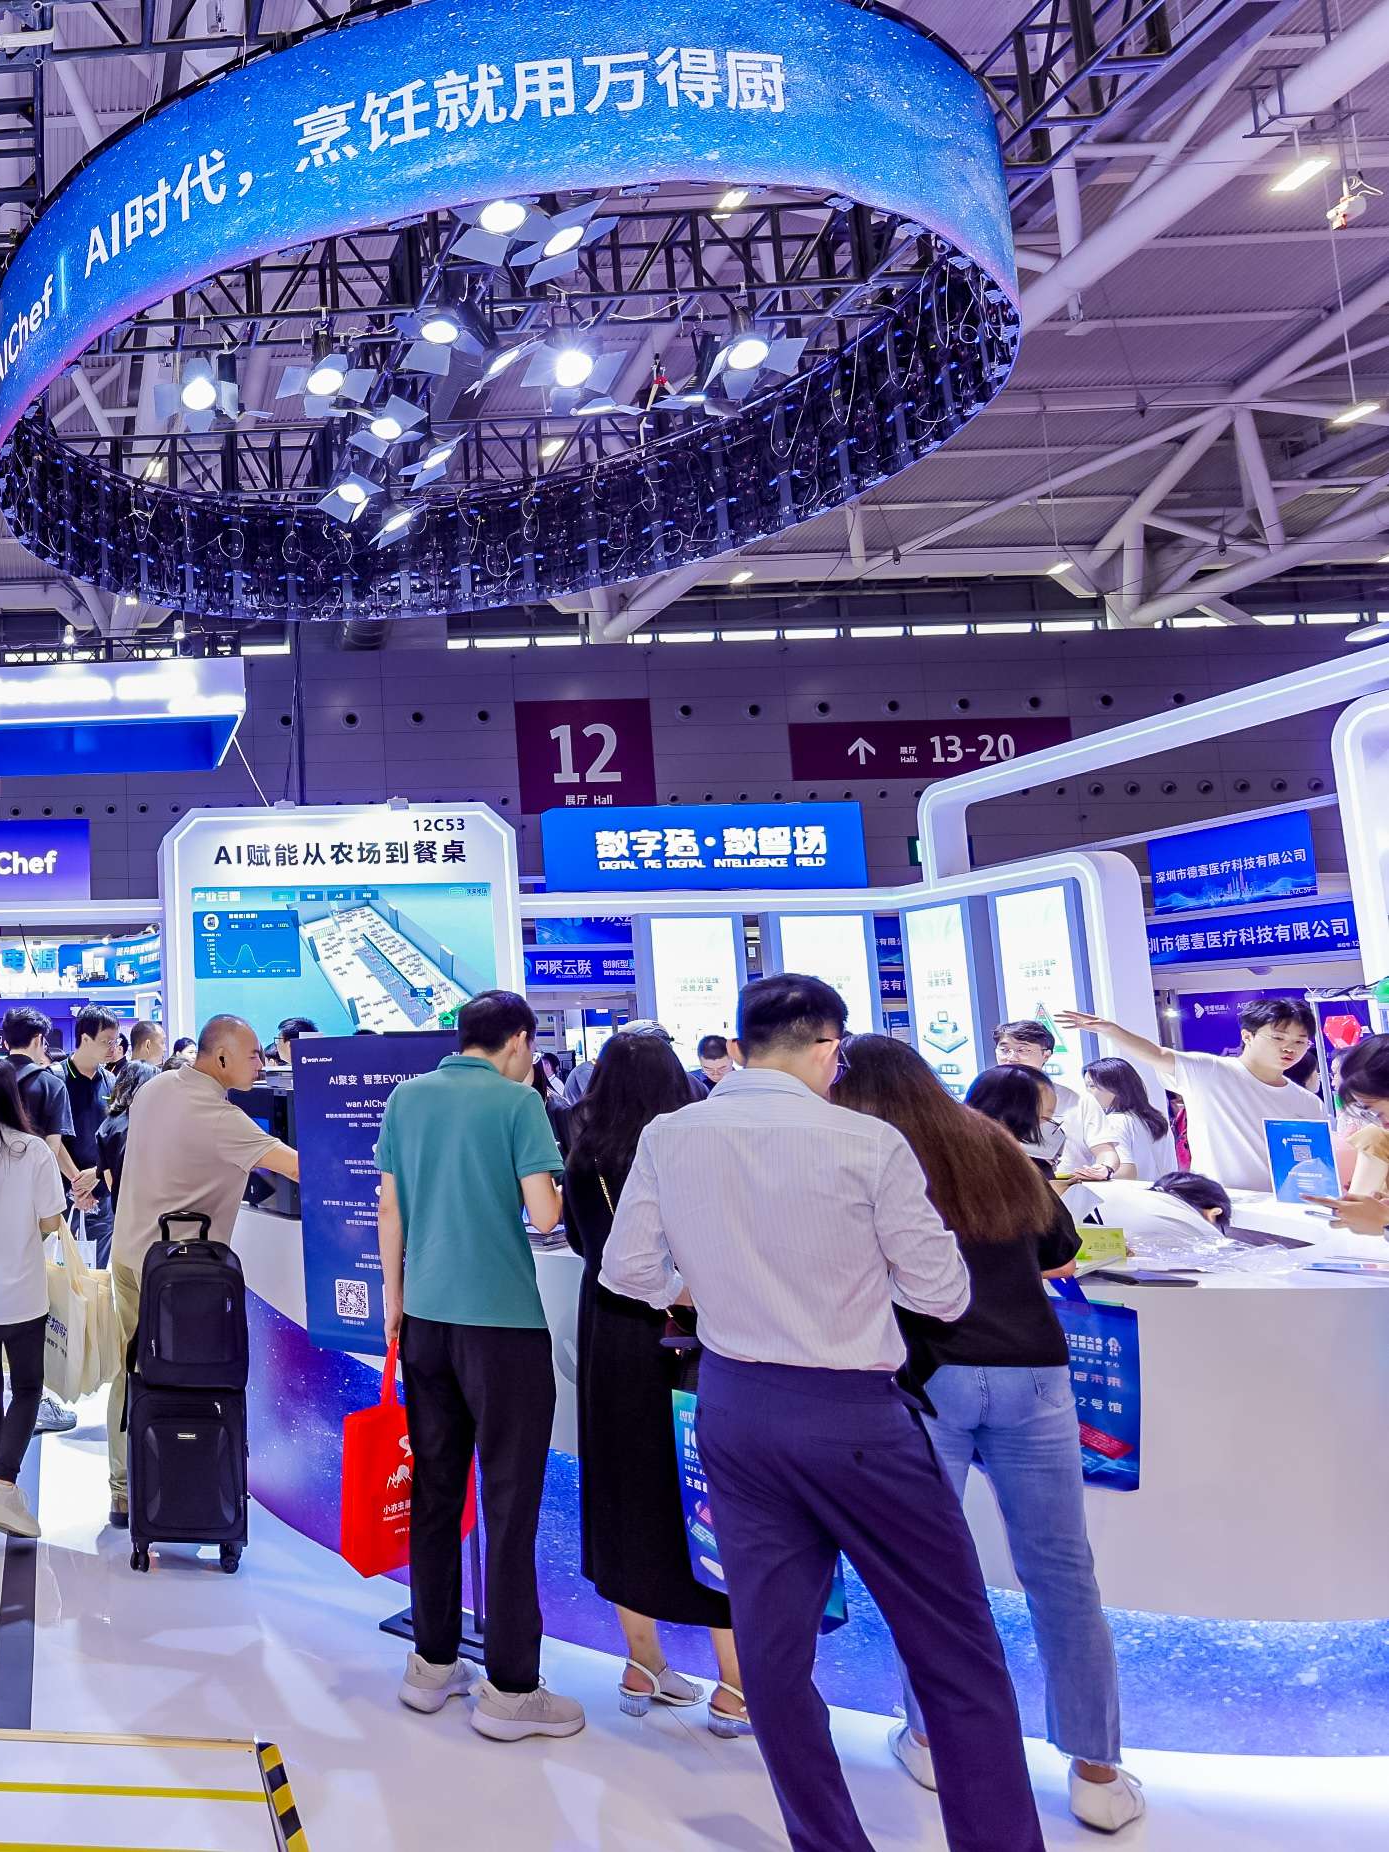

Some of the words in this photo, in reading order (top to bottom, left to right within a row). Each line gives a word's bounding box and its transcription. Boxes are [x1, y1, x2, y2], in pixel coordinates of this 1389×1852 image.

[83, 150, 256, 276] AI时代，
[294, 47, 785, 172] 烹饪就用万得厨
[549, 723, 622, 784] 12
[899, 746, 917, 755] 展厅
[929, 734, 1016, 763] 13-20
[900, 755, 918, 763] Halls
[565, 794, 588, 805] 展厅
[593, 794, 613, 805] Hall
[413, 818, 465, 832] 12C53
[213, 840, 466, 867] AI赋能从农场到餐桌
[598, 860, 639, 870] DIGITAL
[644, 860, 662, 869] PIG
[666, 859, 706, 869] DIGITAL
[713, 857, 788, 868] INTELLIGENCE
[795, 857, 826, 867] FIELD
[1155, 848, 1307, 884] 深圳市德壹医疗科技有限公司
[535, 959, 592, 975] 网聚云联
[329, 1074, 358, 1086] AI聚变
[363, 1100, 388, 1108] AIChe
